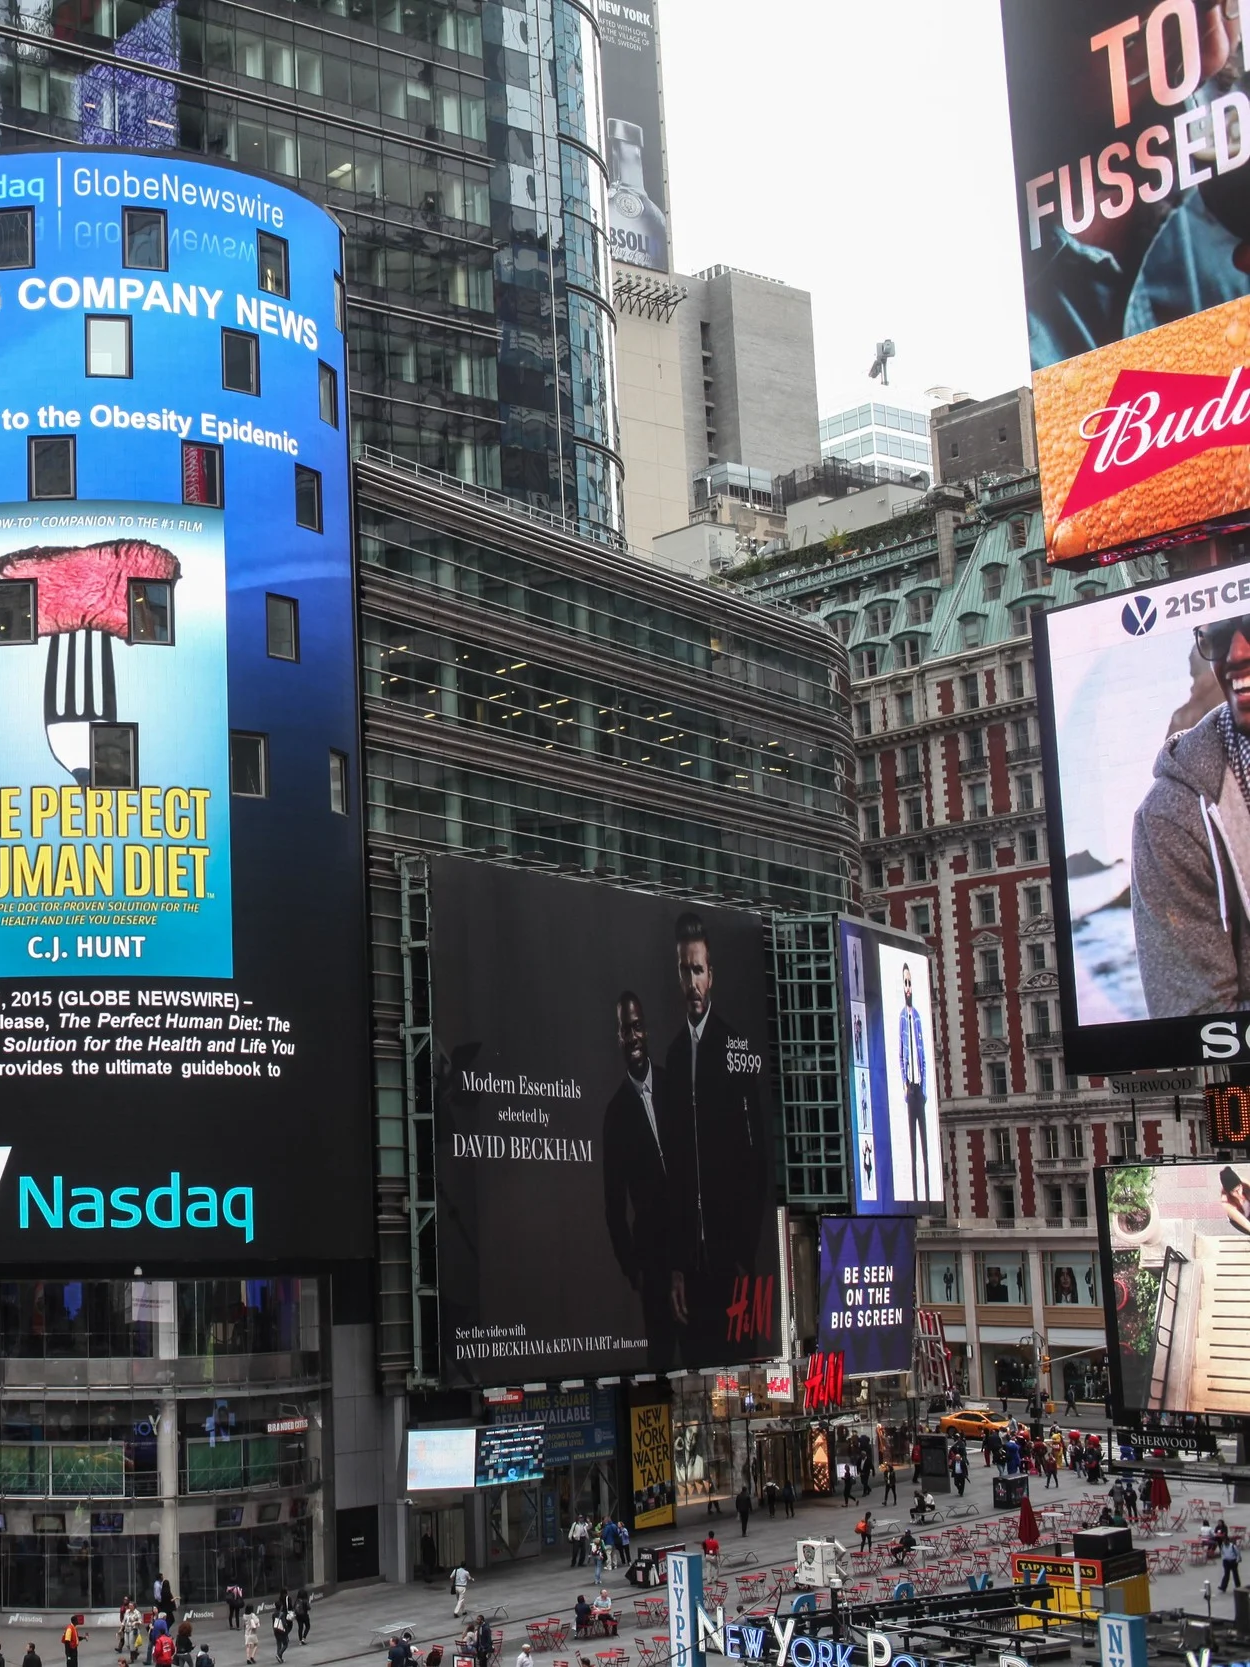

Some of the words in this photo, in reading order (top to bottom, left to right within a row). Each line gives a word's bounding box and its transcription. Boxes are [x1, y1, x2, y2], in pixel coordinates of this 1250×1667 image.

[599, 0, 620, 16] NEW
[622, 6, 653, 29] YORK,
[1090, 0, 1201, 129] TO
[1026, 91, 1250, 250] FUSSED
[74, 168, 283, 228] GlobeNewswire
[18, 277, 223, 319] COMPANY
[236, 297, 318, 351] NEWS
[2, 407, 30, 429] to
[37, 405, 81, 427] the
[90, 404, 192, 439] Obesity
[200, 413, 299, 456] Epidemic
[41, 516, 115, 528] COMPANION
[118, 516, 134, 527] TO
[137, 517, 158, 528] THE
[160, 518, 175, 530] #1
[178, 520, 203, 533] FILM
[1165, 586, 1219, 619] 21ST
[31, 786, 211, 840] PERFECT
[17, 901, 105, 912] DOCTOR-PROVEN
[107, 901, 158, 912] SOLUTION
[160, 902, 180, 912] FOR
[182, 903, 199, 913] THE
[1, 916, 38, 926] HEALTH
[40, 915, 63, 925] AND
[66, 915, 85, 925] LIFE
[88, 915, 110, 925] YOU
[112, 915, 157, 925] DESERVE
[27, 936, 68, 962] C.J.
[76, 936, 146, 958] HUNT
[11, 991, 52, 1007] 2015
[58, 991, 130, 1009] (GLOBE
[137, 991, 239, 1011] NEWSWIRE)
[59, 1013, 91, 1029] The
[97, 1013, 161, 1029] Perfect
[165, 1013, 223, 1030] Human
[228, 1014, 263, 1031] Diet:
[267, 1016, 290, 1032] The
[3, 1036, 77, 1053] Solution
[83, 1036, 110, 1051] for
[115, 1036, 143, 1051] the
[148, 1036, 202, 1051] Health
[207, 1037, 235, 1053] and
[240, 1038, 267, 1054] Life
[271, 1039, 295, 1055] You
[725, 1036, 748, 1051] Jacket
[1200, 1021, 1250, 1059] S
[71, 1059, 99, 1075] the
[105, 1059, 172, 1075] ultimate
[181, 1060, 261, 1078] guidebook
[267, 1062, 281, 1077] to
[726, 1050, 762, 1074] $59.99
[461, 1070, 516, 1094] Modern
[518, 1074, 582, 1100] Essentials
[1112, 1079, 1191, 1095] SHERWOOD
[498, 1108, 536, 1123] selected
[539, 1110, 550, 1127] by
[452, 1133, 505, 1159] DAVID
[510, 1135, 593, 1162] BECKHAM
[19, 1171, 254, 1244] Nasdaq
[844, 1267, 859, 1284] BE
[863, 1265, 893, 1283] SEEN
[726, 1274, 774, 1343] H&M
[846, 1289, 863, 1305] ON
[868, 1288, 890, 1304] THE
[831, 1311, 853, 1329] BIG
[857, 1308, 903, 1327] SCREEN
[455, 1327, 470, 1340] See
[471, 1325, 484, 1338] the
[486, 1324, 508, 1338] video
[509, 1323, 526, 1336] with
[456, 1342, 490, 1360] DAVID
[492, 1340, 544, 1357] BECKHAM
[553, 1338, 584, 1353] KEVIN
[585, 1336, 612, 1351] HART
[613, 1340, 620, 1350] at
[621, 1337, 648, 1349] hm.com
[804, 1350, 844, 1409] H&M
[525, 1396, 551, 1410] TIMES
[554, 1393, 590, 1408] SQUARE
[534, 1406, 590, 1425] AVAILABLE
[637, 1406, 662, 1430] NEW
[635, 1424, 666, 1450] YORK
[1130, 1433, 1197, 1449] SHERWOOD
[633, 1443, 670, 1469] WATER
[640, 1463, 665, 1487] TAXI
[1060, 1566, 1093, 1577] PAAS
[19, 1614, 43, 1624] Nasdaq
[193, 1610, 214, 1620] Nasdaq
